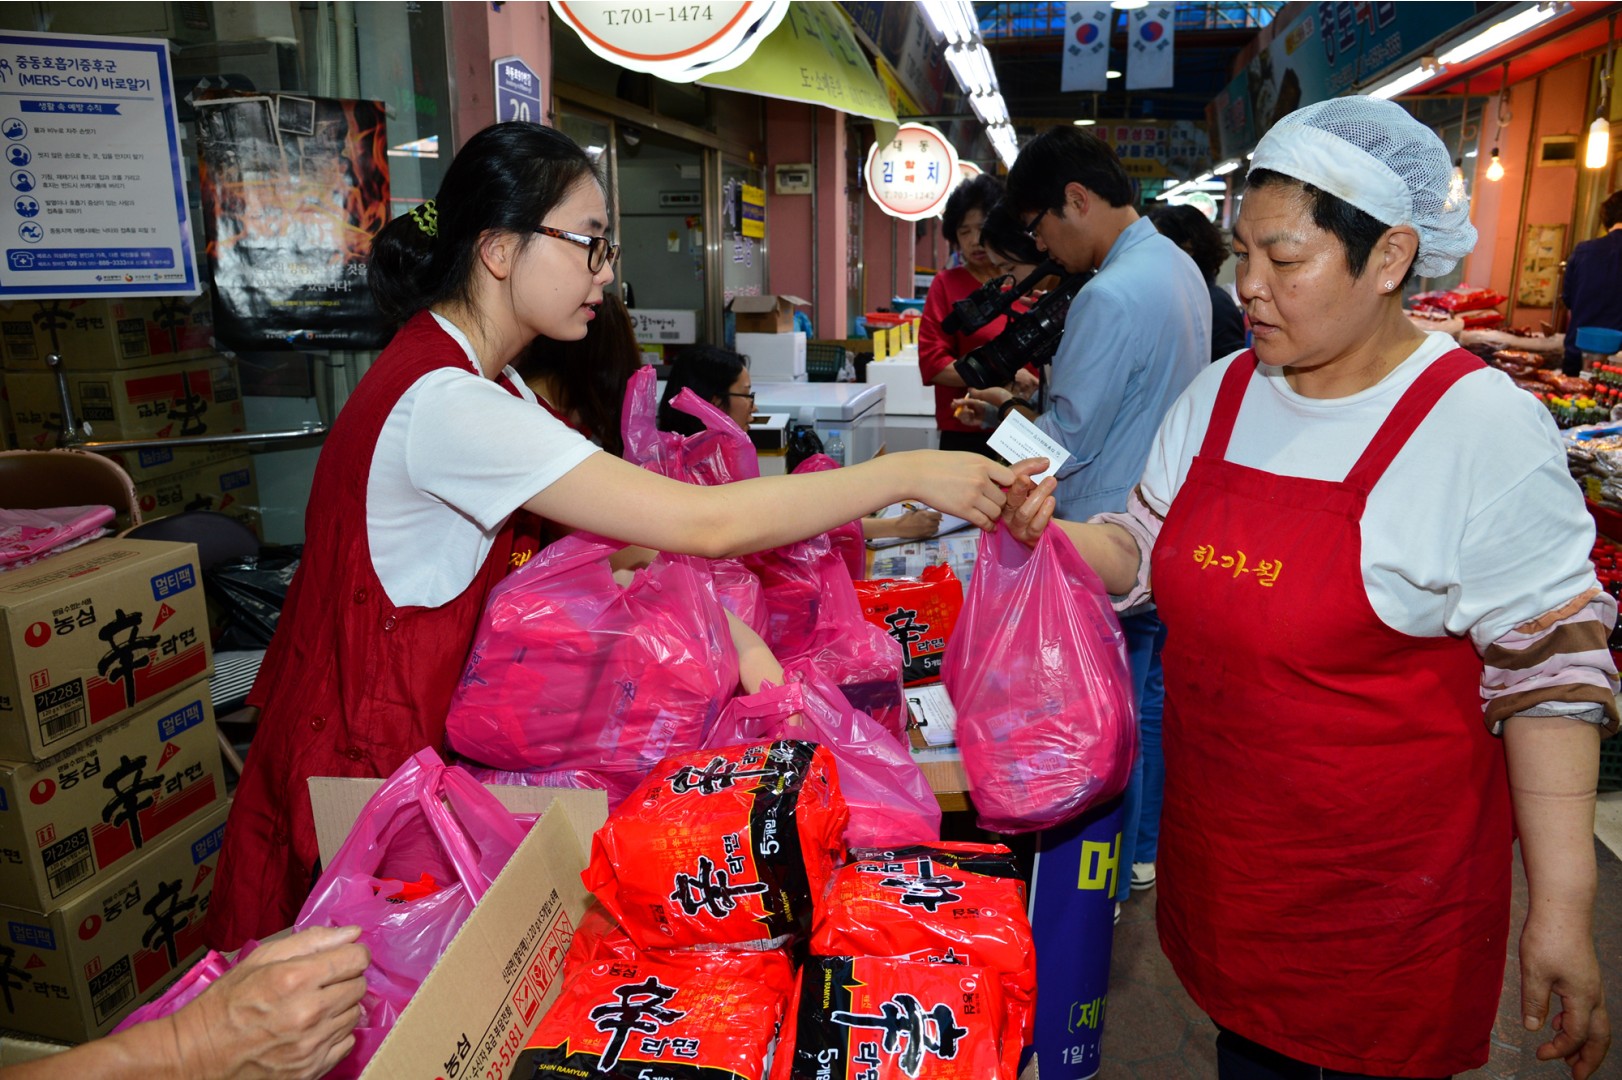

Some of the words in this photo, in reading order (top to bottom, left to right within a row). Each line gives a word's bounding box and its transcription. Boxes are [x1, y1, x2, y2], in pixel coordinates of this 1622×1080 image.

[603, 3, 714, 26] T.701-1474
[16, 55, 117, 73] 중동호흡기증후군
[18, 72, 98, 90] (MERS-CoV)
[102, 78, 150, 91] 바로알기
[39, 102, 54, 112] 생활
[68, 104, 84, 112] 예방
[87, 104, 102, 113] 수칙
[155, 568, 192, 596] 멀티팩
[54, 606, 97, 636] 농심
[161, 627, 198, 657] 라면
[917, 638, 946, 652] 라면
[98, 608, 162, 708] 辛
[38, 682, 82, 708] 가2283
[162, 706, 200, 738] 멀티팩
[58, 756, 101, 790] 농심
[166, 762, 204, 794] 라면
[102, 755, 165, 848] 辛
[45, 832, 88, 862] 가2283
[760, 819, 781, 856] 5개입
[722, 832, 746, 876] 라면
[670, 856, 770, 919] 辛
[104, 886, 141, 922] 농심
[12, 924, 51, 944] 멀티팩
[142, 878, 198, 968] 辛
[91, 958, 129, 993] 가2283
[608, 966, 636, 979] 농심
[34, 980, 70, 1000] 라면
[822, 982, 831, 1009] RAMYUN
[588, 976, 688, 1072] 辛
[831, 994, 968, 1078] 辛
[444, 1032, 472, 1078] 농심
[640, 1036, 700, 1059] 라면
[538, 1062, 556, 1072] SHIN
[556, 1064, 590, 1078] RAMYUN
